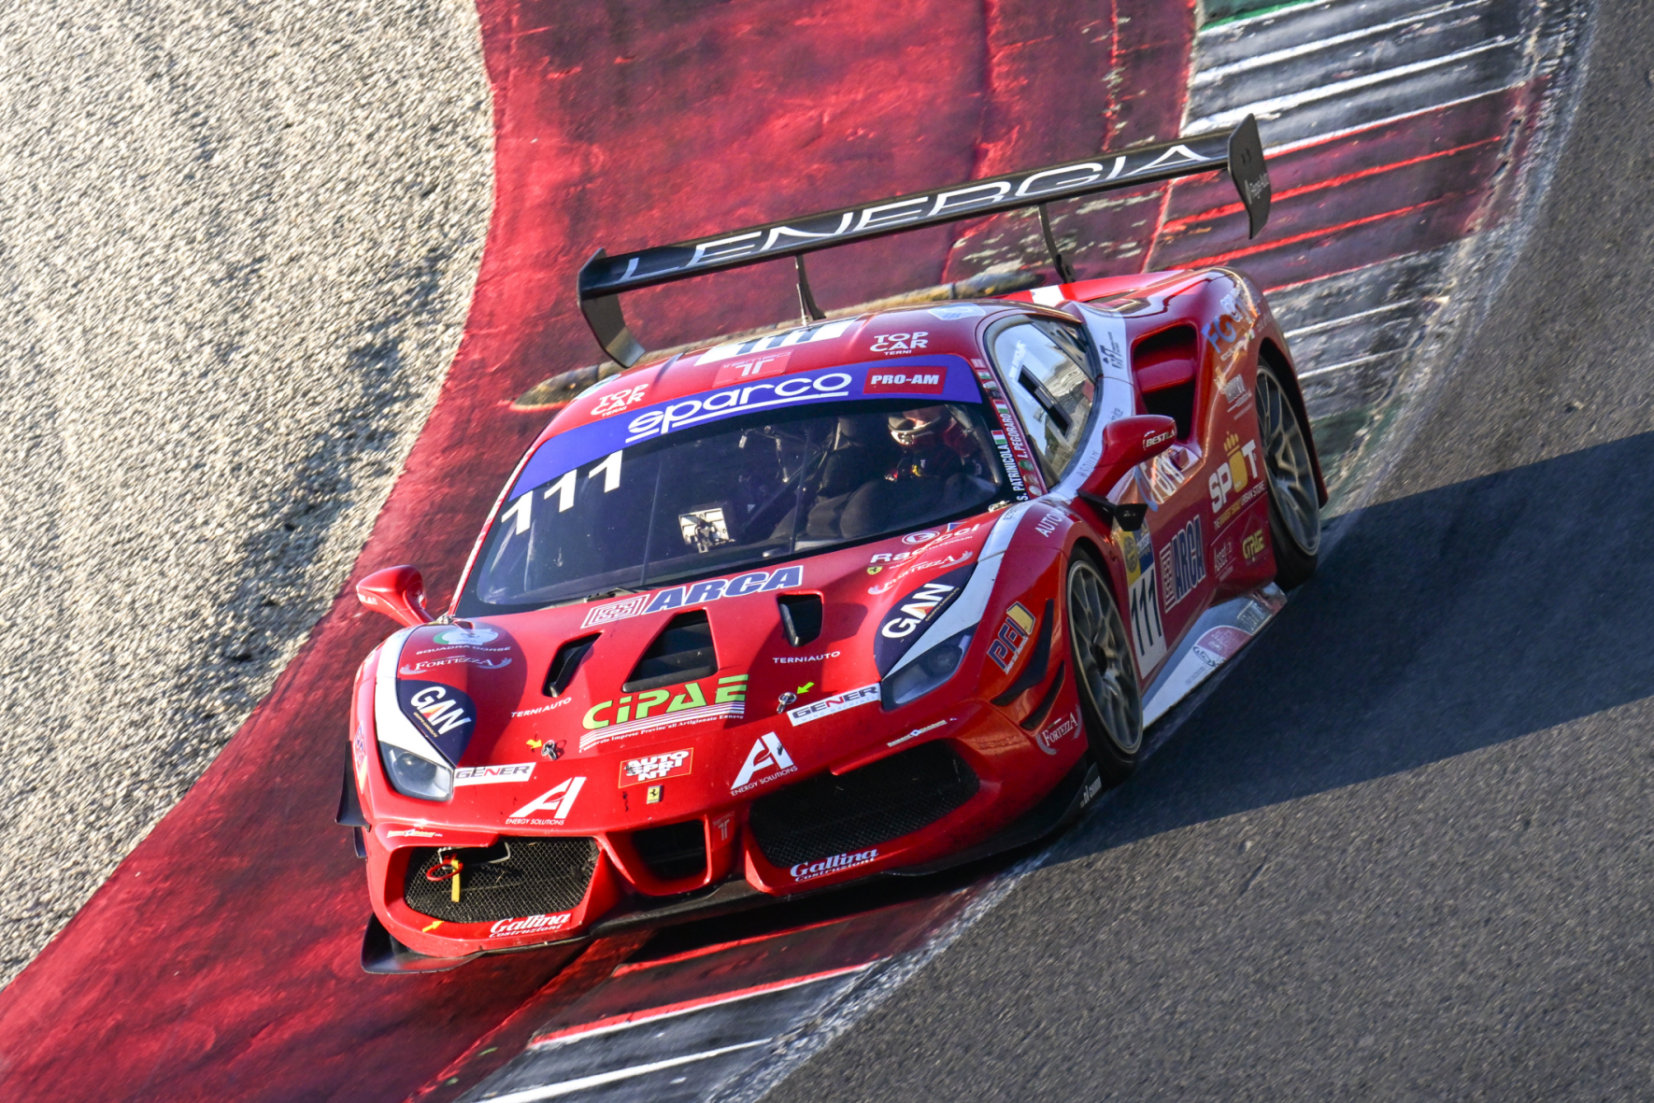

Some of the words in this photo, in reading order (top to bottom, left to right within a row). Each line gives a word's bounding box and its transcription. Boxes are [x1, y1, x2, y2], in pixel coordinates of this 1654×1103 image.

[870, 339, 928, 352] CAR
[874, 331, 928, 343] TOP
[599, 384, 649, 406] TOP
[870, 374, 940, 386] PRO-AM
[591, 392, 646, 415] CAR
[628, 373, 853, 435] sparco
[997, 443, 1026, 492] PATRINICOLA
[501, 450, 623, 536] 111
[1171, 514, 1207, 601] ARCA
[642, 565, 804, 615] ARCA
[881, 583, 955, 639] GAN
[1131, 568, 1162, 657] 111
[772, 651, 841, 664] TERNIAUTO
[410, 686, 472, 735] GAN
[511, 697, 573, 718] TERNIAUTO
[792, 686, 878, 718] GENER
[1041, 711, 1078, 747] FORTEZZA
[456, 765, 530, 779] GENER
[628, 751, 689, 767] AUTO
[730, 781, 758, 797] ENERGY
[759, 765, 799, 786] SOLUTIONS
[505, 818, 530, 826] ENERGY
[530, 818, 565, 826] SOLUTIONS
[789, 848, 878, 878] Gallina
[490, 912, 572, 934] Gallina
